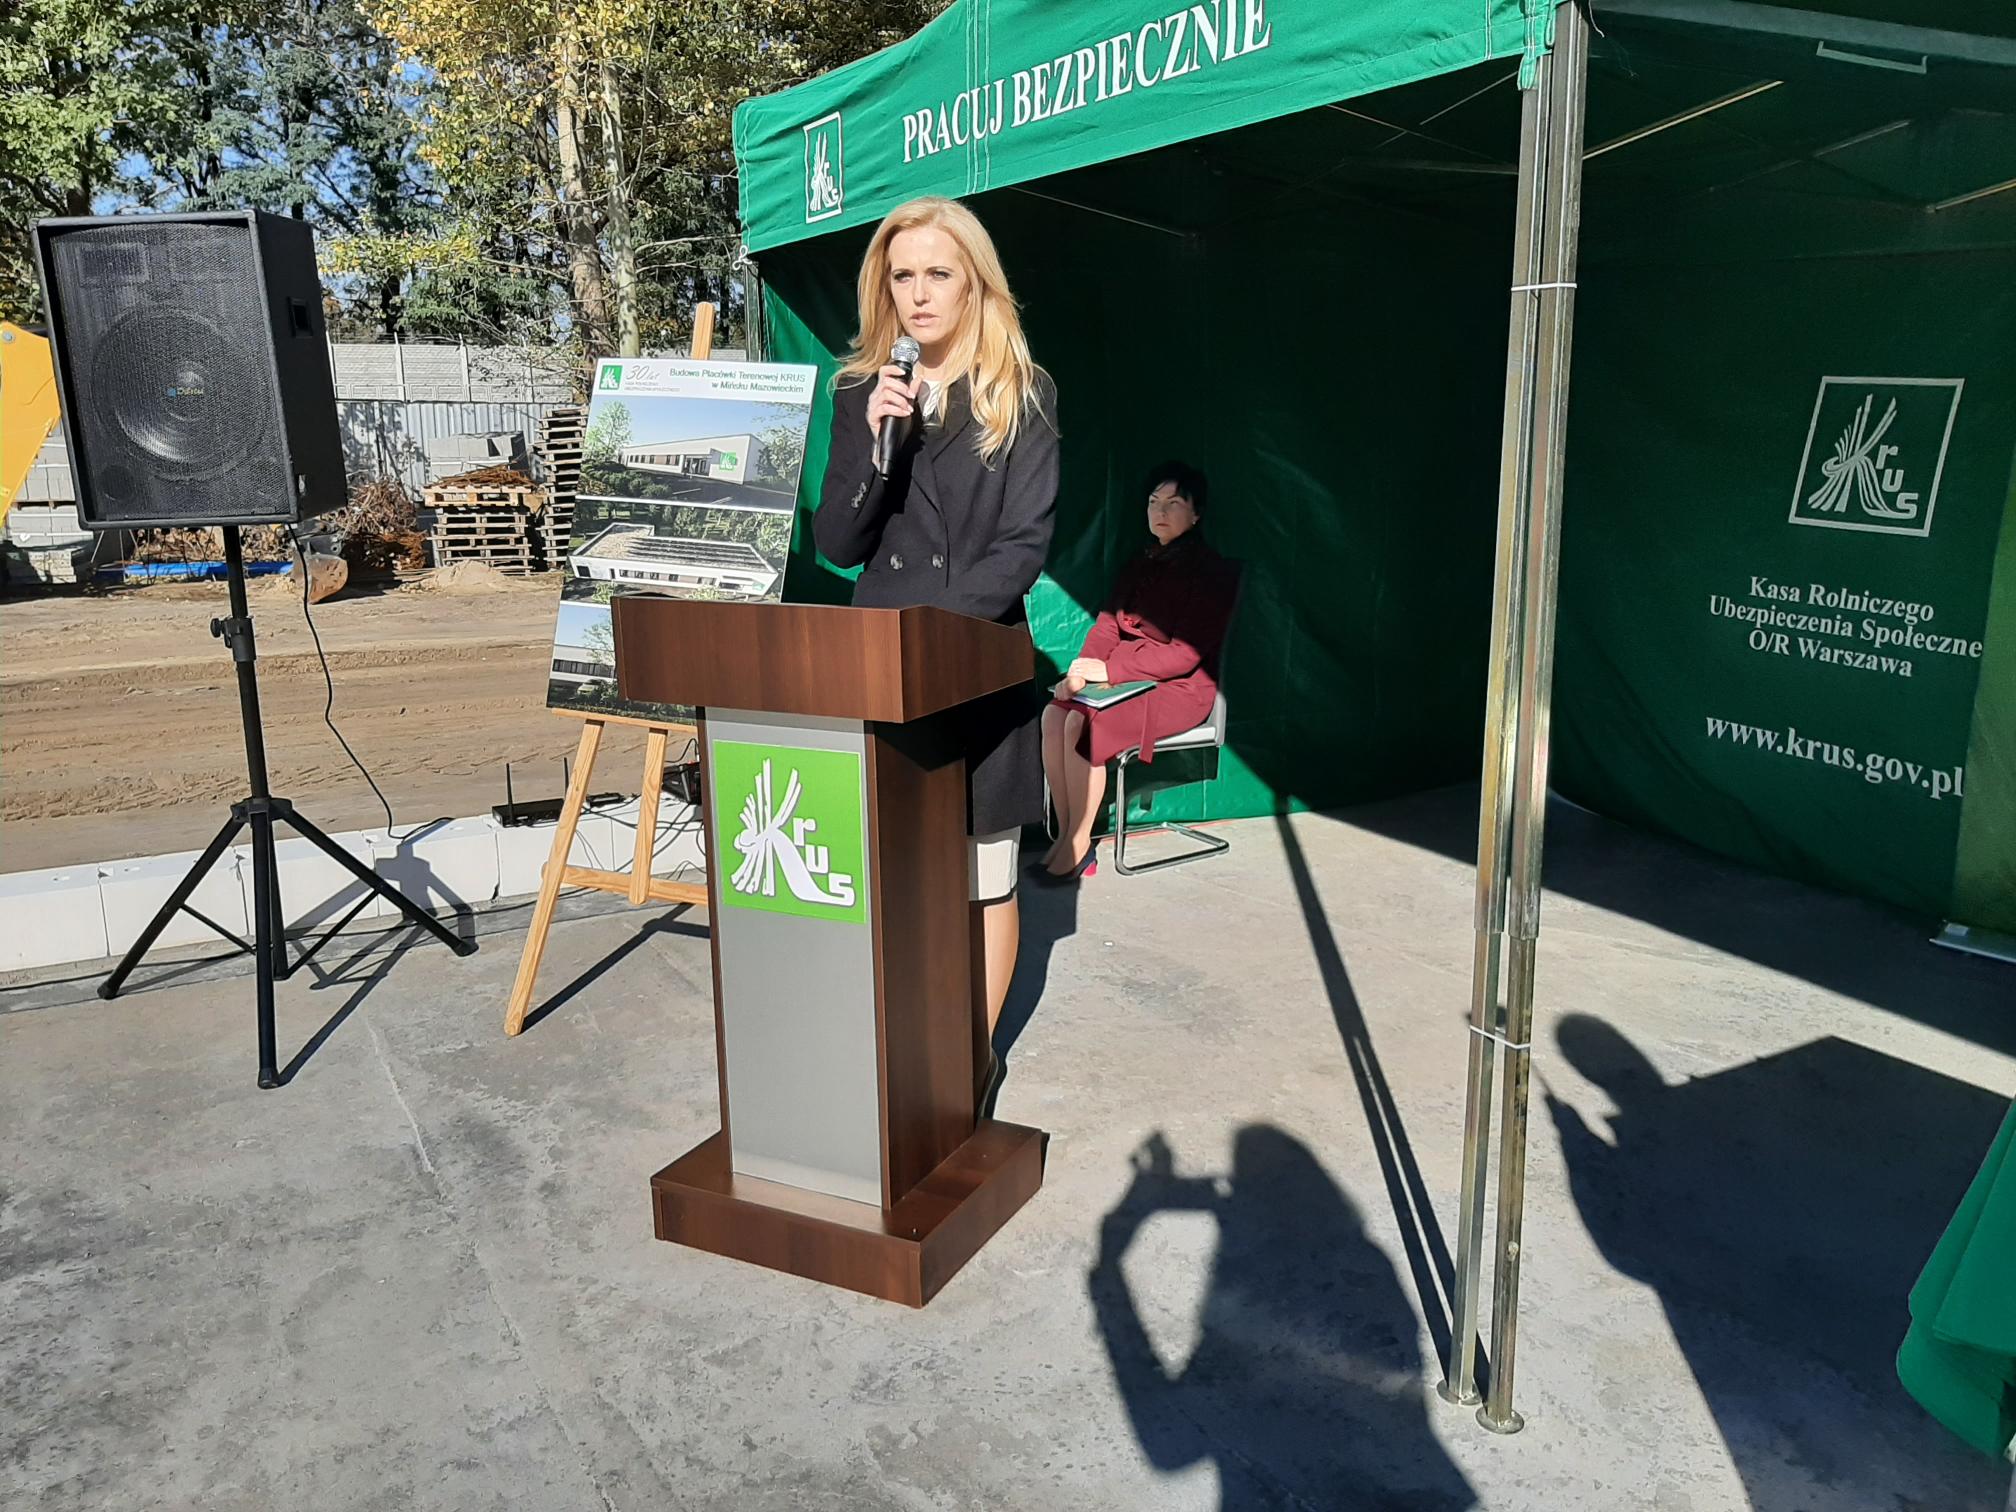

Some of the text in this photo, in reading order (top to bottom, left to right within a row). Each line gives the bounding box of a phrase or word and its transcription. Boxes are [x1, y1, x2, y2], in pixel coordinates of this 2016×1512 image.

[902, 0, 1272, 163] PRACUJ BEZPIECZNIE
[626, 365, 650, 381] 30
[669, 368, 806, 383] Budowa Placówki Terenowej KRUS
[720, 381, 749, 391] Mińsku
[750, 382, 804, 393] Mazowieckim
[1748, 576, 1935, 625] Kasa Rolniczego
[1709, 595, 1984, 659] Ubezpieczenia Społeczne
[1748, 629, 1913, 678] O/R Warszawa
[1705, 716, 1965, 800] www.krus.gov.pl
